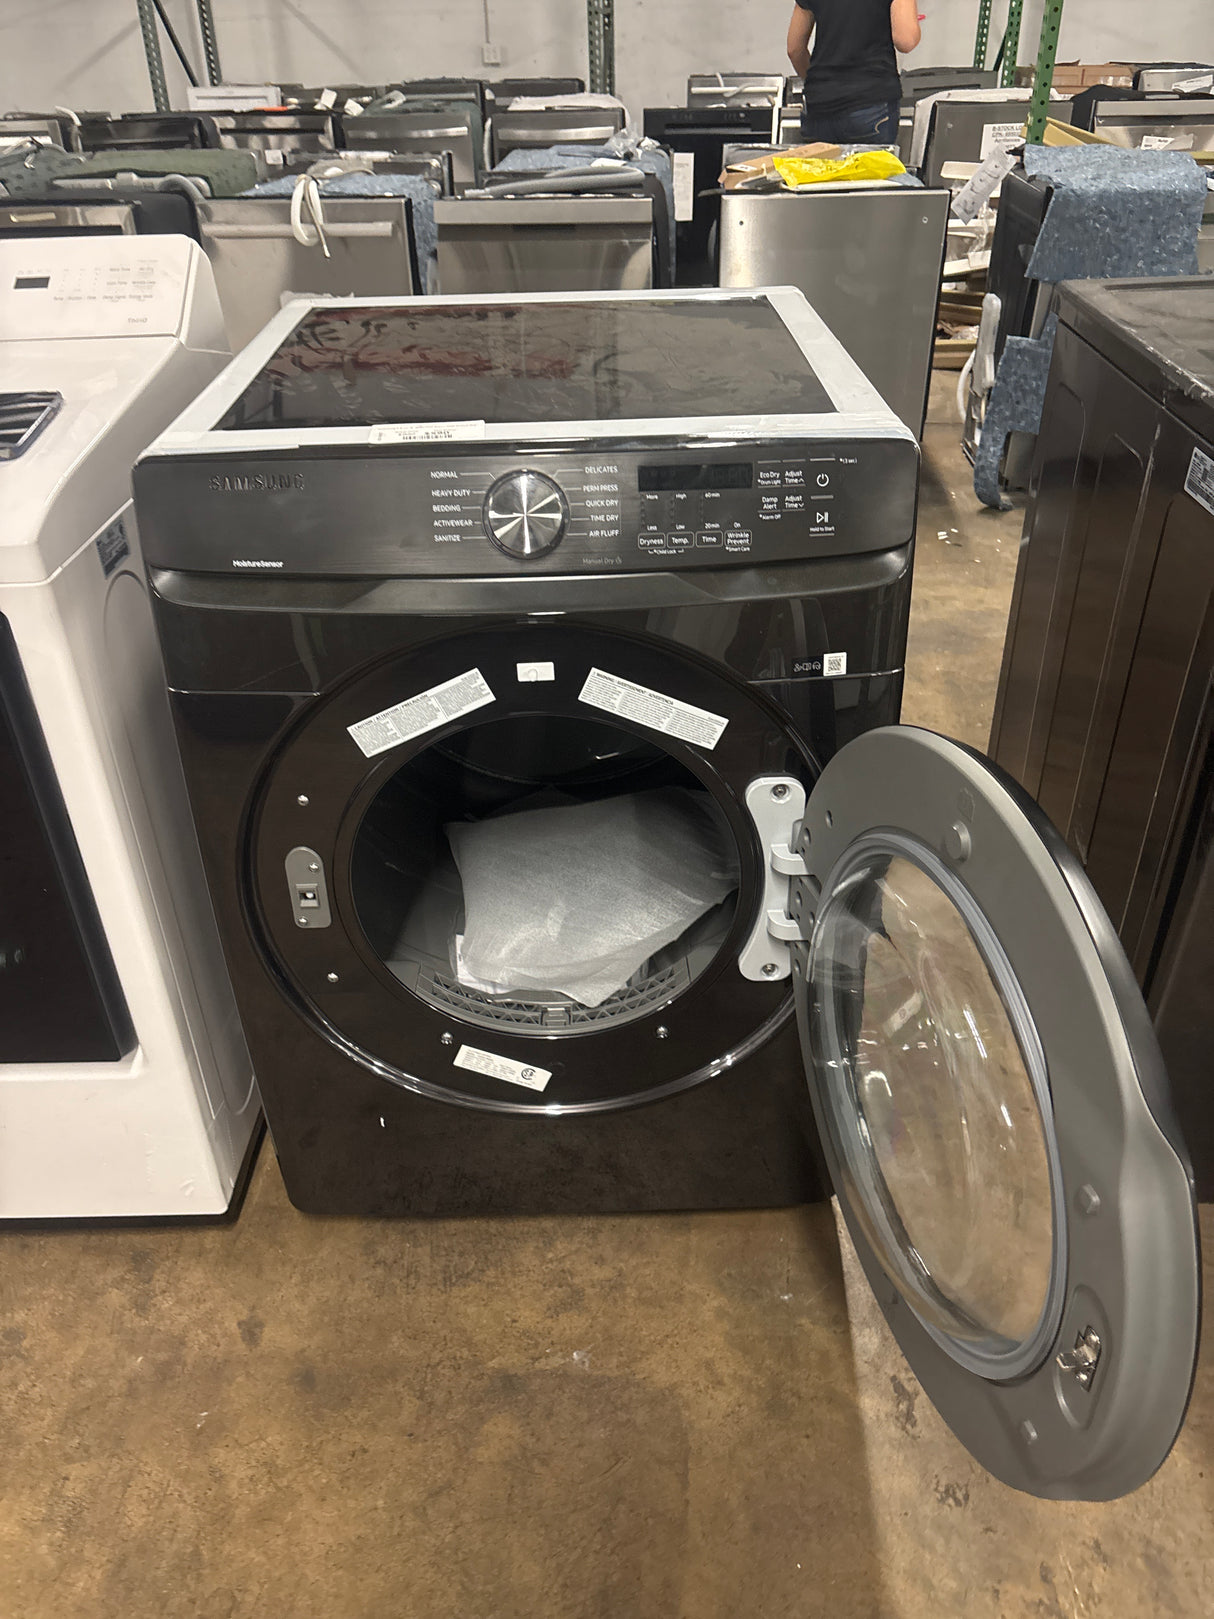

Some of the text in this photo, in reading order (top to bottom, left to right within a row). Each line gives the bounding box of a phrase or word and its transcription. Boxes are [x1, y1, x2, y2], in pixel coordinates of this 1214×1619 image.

[584, 465, 619, 474] DELICATES
[430, 471, 458, 479] NORMAL
[208, 474, 304, 491] SAMSUNG
[583, 483, 619, 493] PERM PRESS
[431, 489, 453, 497] HEAVY
[585, 500, 605, 508] QUICK
[432, 504, 461, 513] BEDDING
[590, 514, 605, 522] TIME
[433, 519, 473, 527] ACTIVEWEAR
[600, 529, 619, 537] FLUFF
[434, 534, 461, 542] SANITIZE
[639, 538, 664, 546] Dryness
[702, 535, 717, 543] Time
